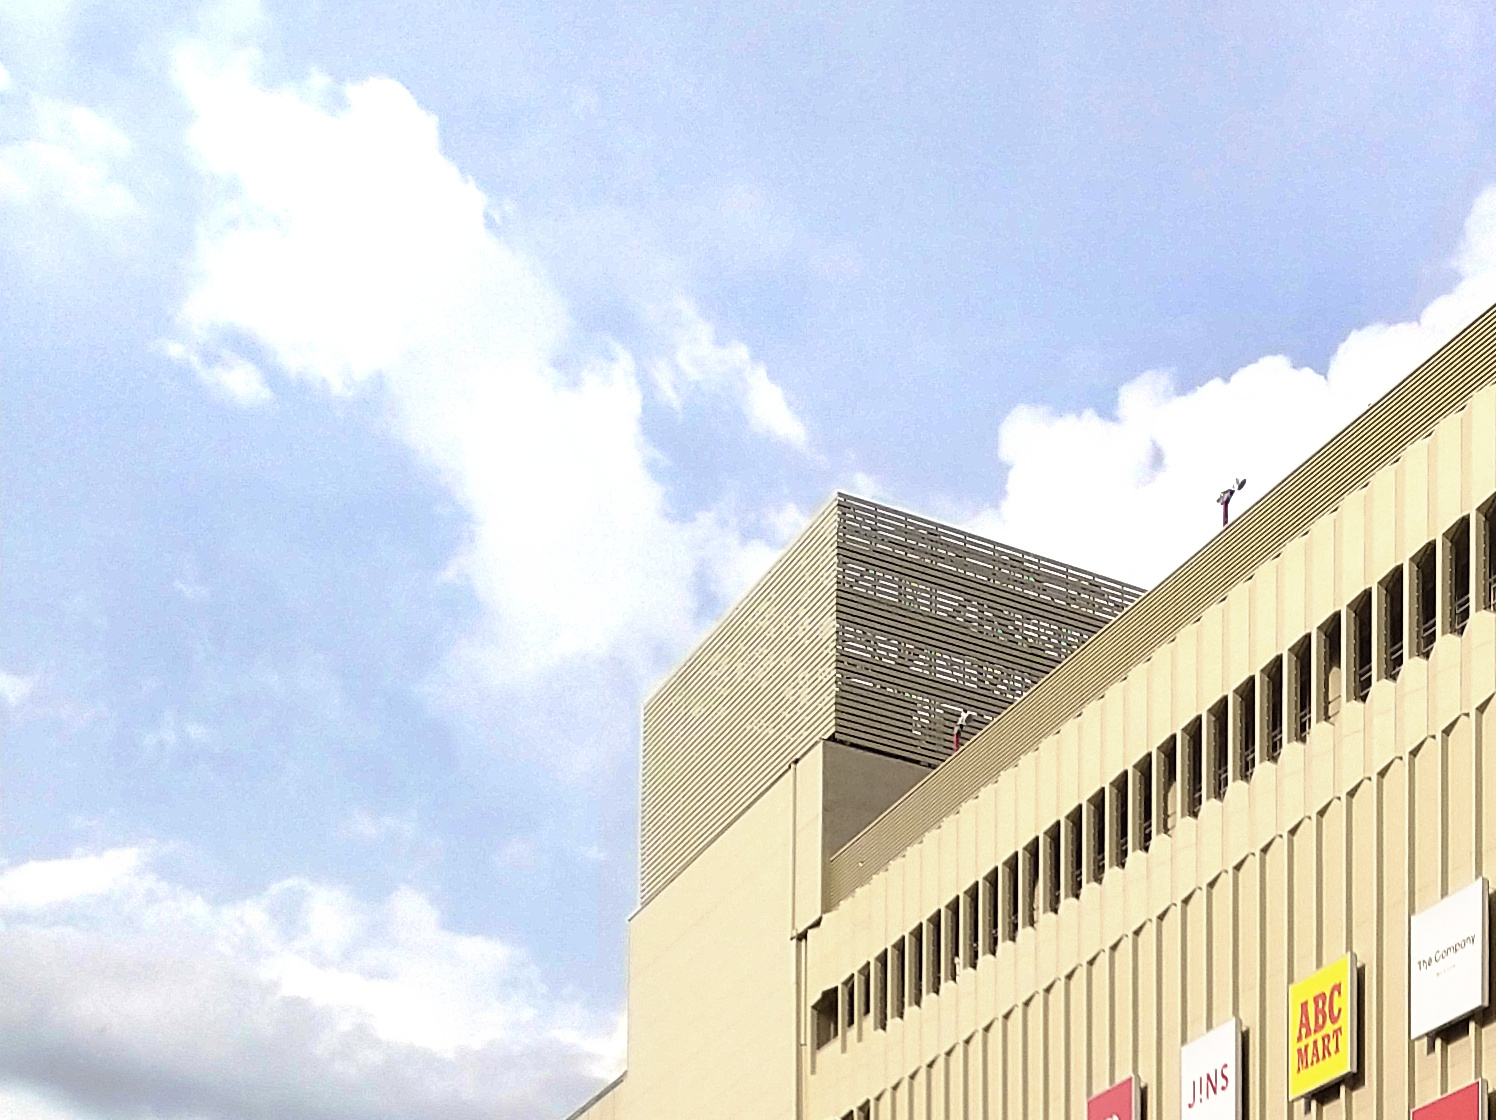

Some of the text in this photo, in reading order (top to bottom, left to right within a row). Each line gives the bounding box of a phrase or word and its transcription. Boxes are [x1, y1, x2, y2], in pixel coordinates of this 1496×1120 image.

[1417, 956, 1433, 971] The
[1434, 934, 1476, 962] Company
[1296, 981, 1342, 1043] ABC
[1296, 1027, 1343, 1075] MART
